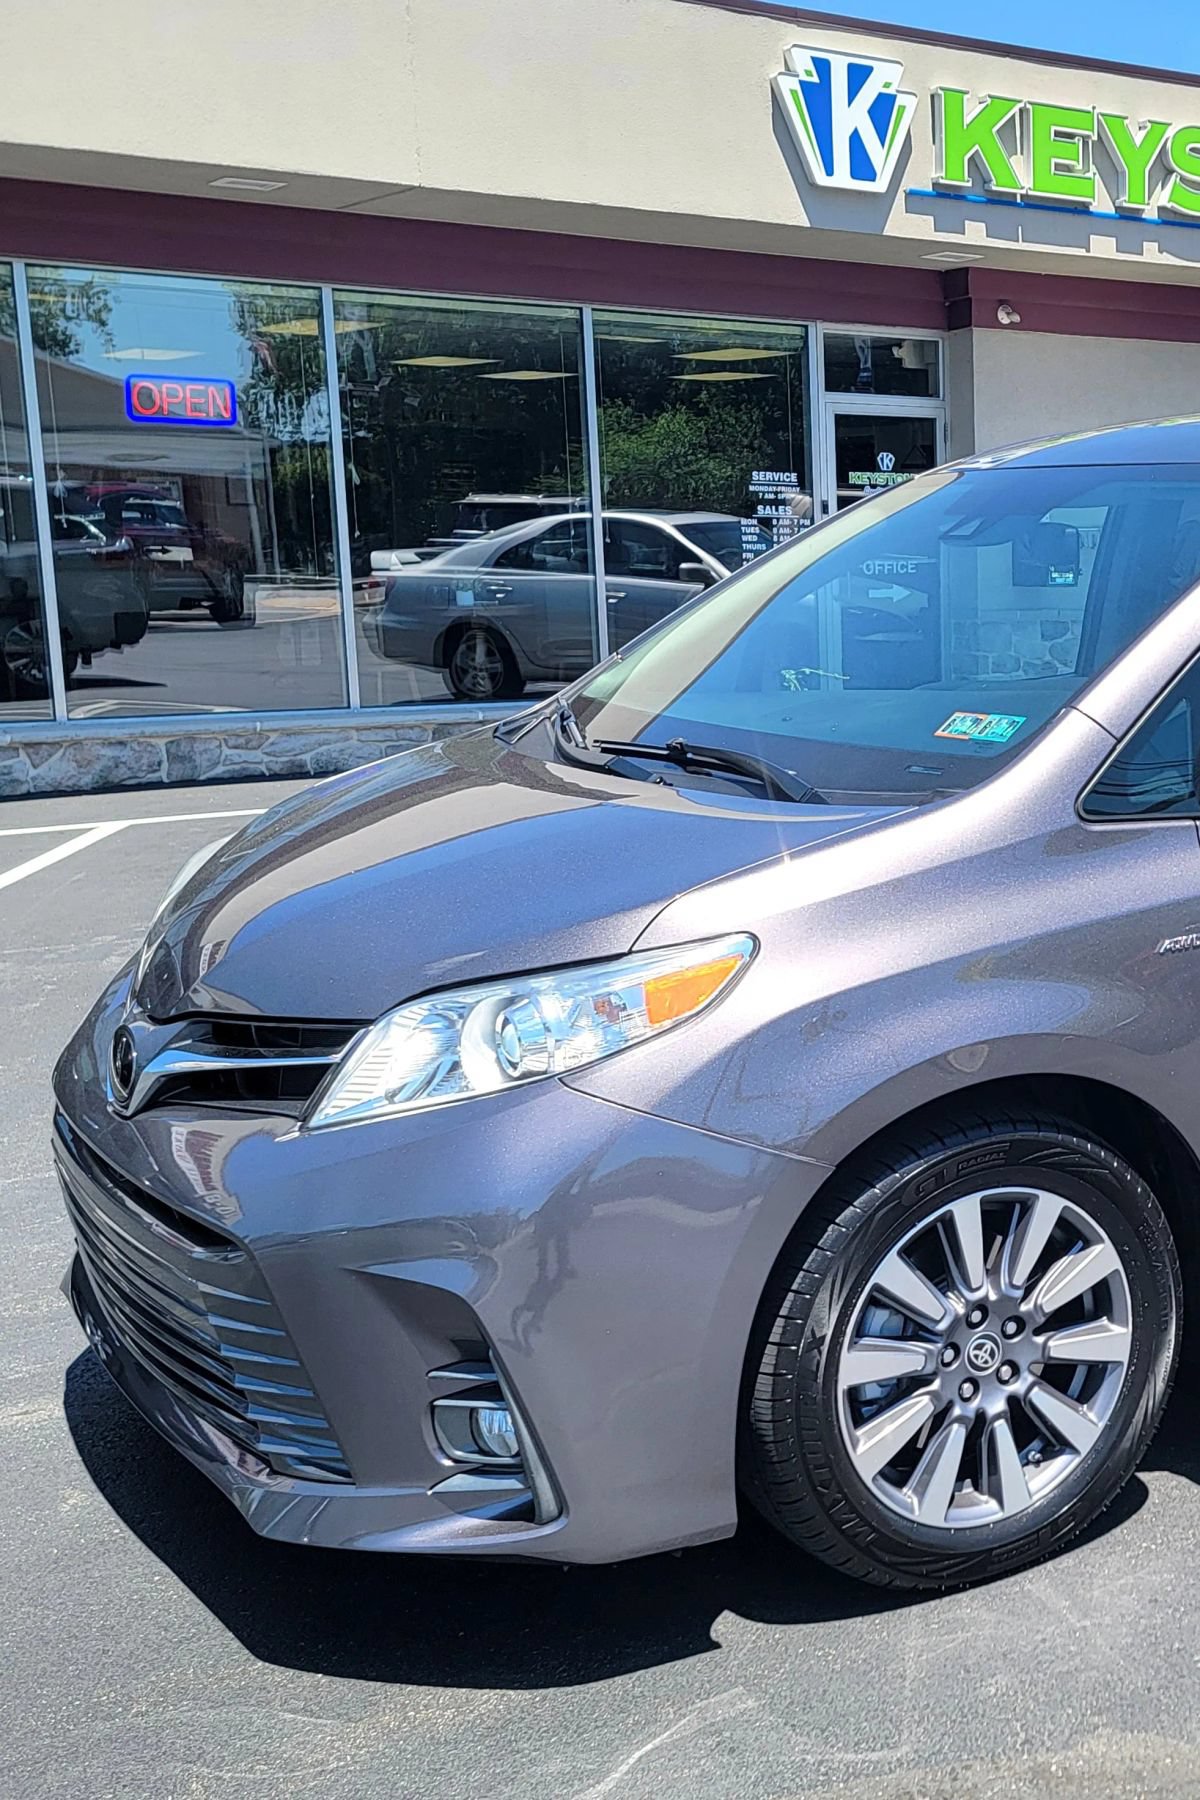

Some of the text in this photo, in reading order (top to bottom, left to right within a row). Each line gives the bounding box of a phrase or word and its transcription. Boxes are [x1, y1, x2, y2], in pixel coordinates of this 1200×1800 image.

[131, 381, 232, 419] OPEN
[751, 470, 798, 482] SERVICE
[748, 484, 801, 493] MONDAY-FRIDAY
[756, 504, 793, 515] SALES
[741, 526, 760, 534] TUES
[741, 534, 758, 542] WED
[742, 552, 755, 560] FRI
[863, 559, 917, 575] OFFICE
